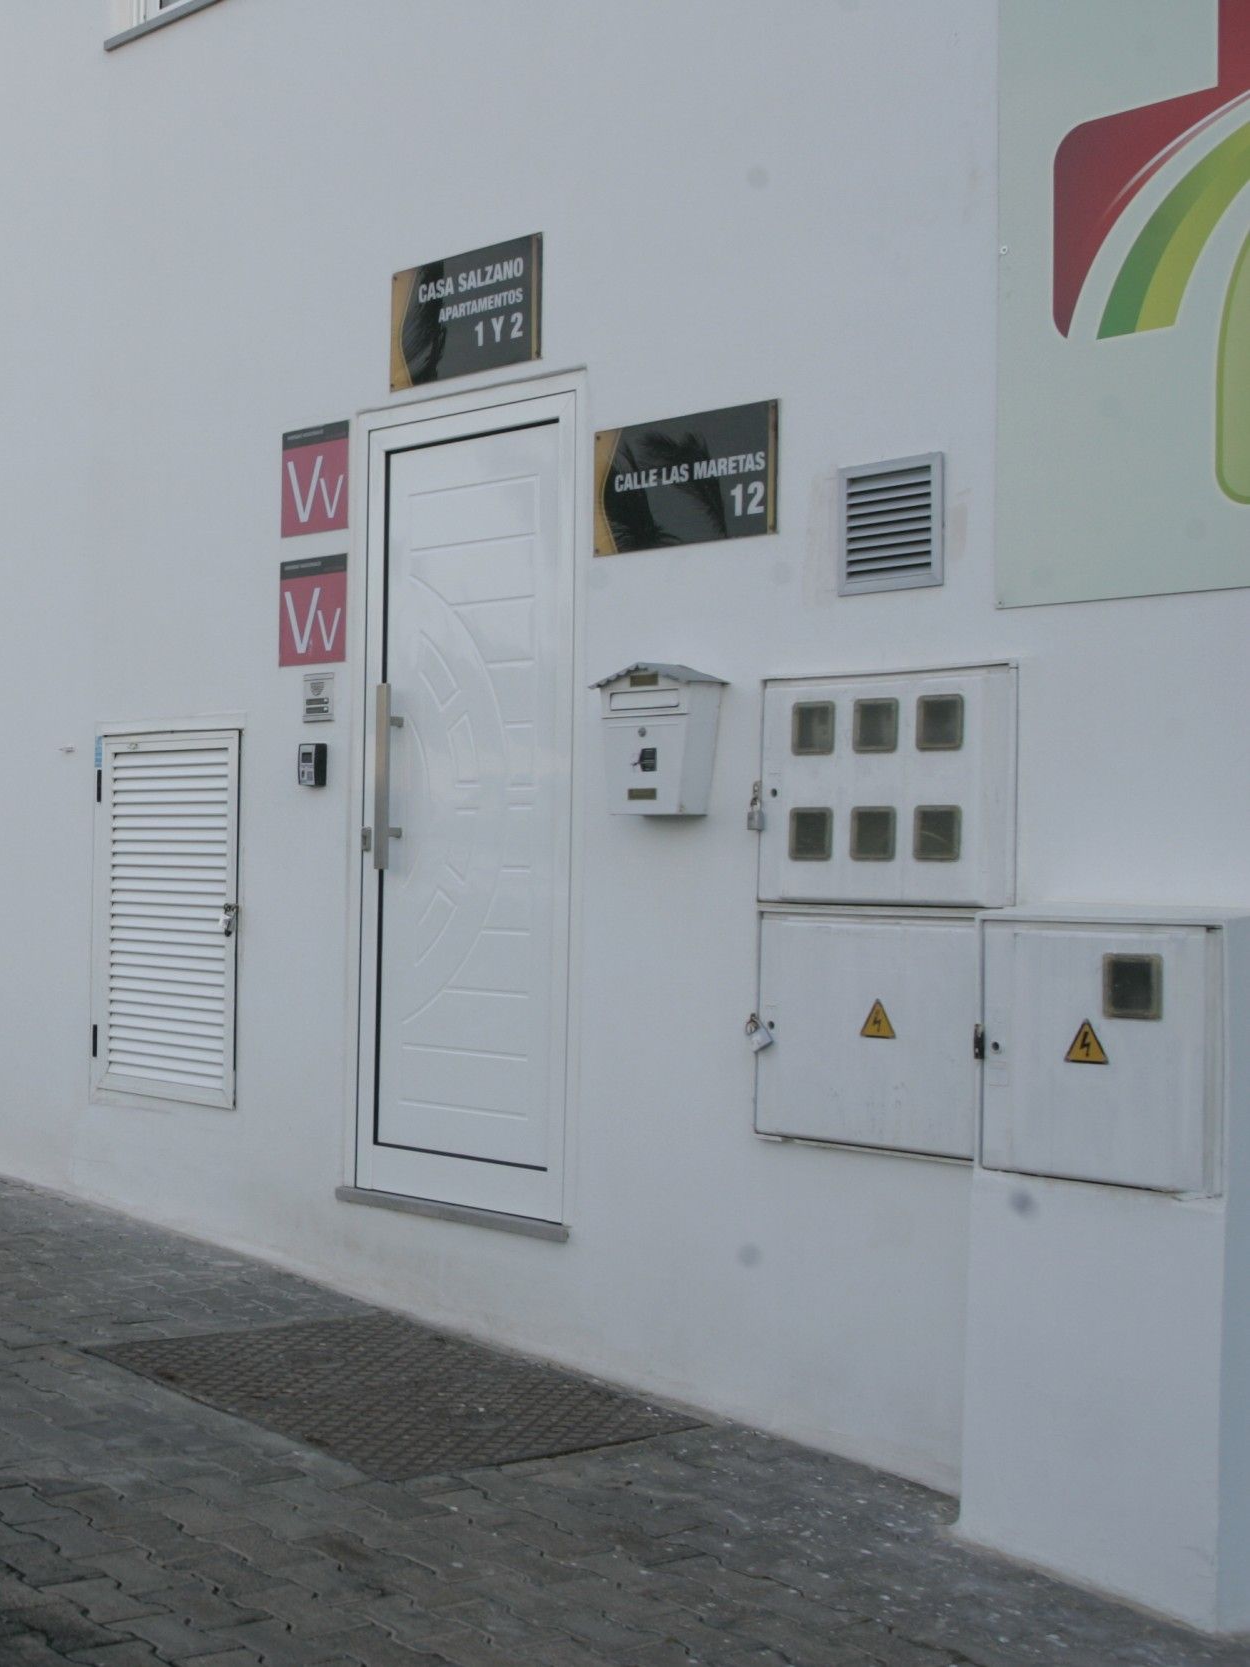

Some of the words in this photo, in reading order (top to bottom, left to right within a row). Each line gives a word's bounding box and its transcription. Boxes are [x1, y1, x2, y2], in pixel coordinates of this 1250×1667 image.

[418, 276, 455, 303] CASA
[457, 256, 524, 292] SALZANO
[438, 287, 524, 323] APARTAMENTOS
[474, 320, 484, 347] 1
[490, 315, 505, 343] Y
[510, 311, 523, 339] 2
[614, 468, 658, 493] CALLE
[661, 463, 690, 486] LAS
[693, 451, 766, 481] MARETAS
[730, 480, 765, 517] 12
